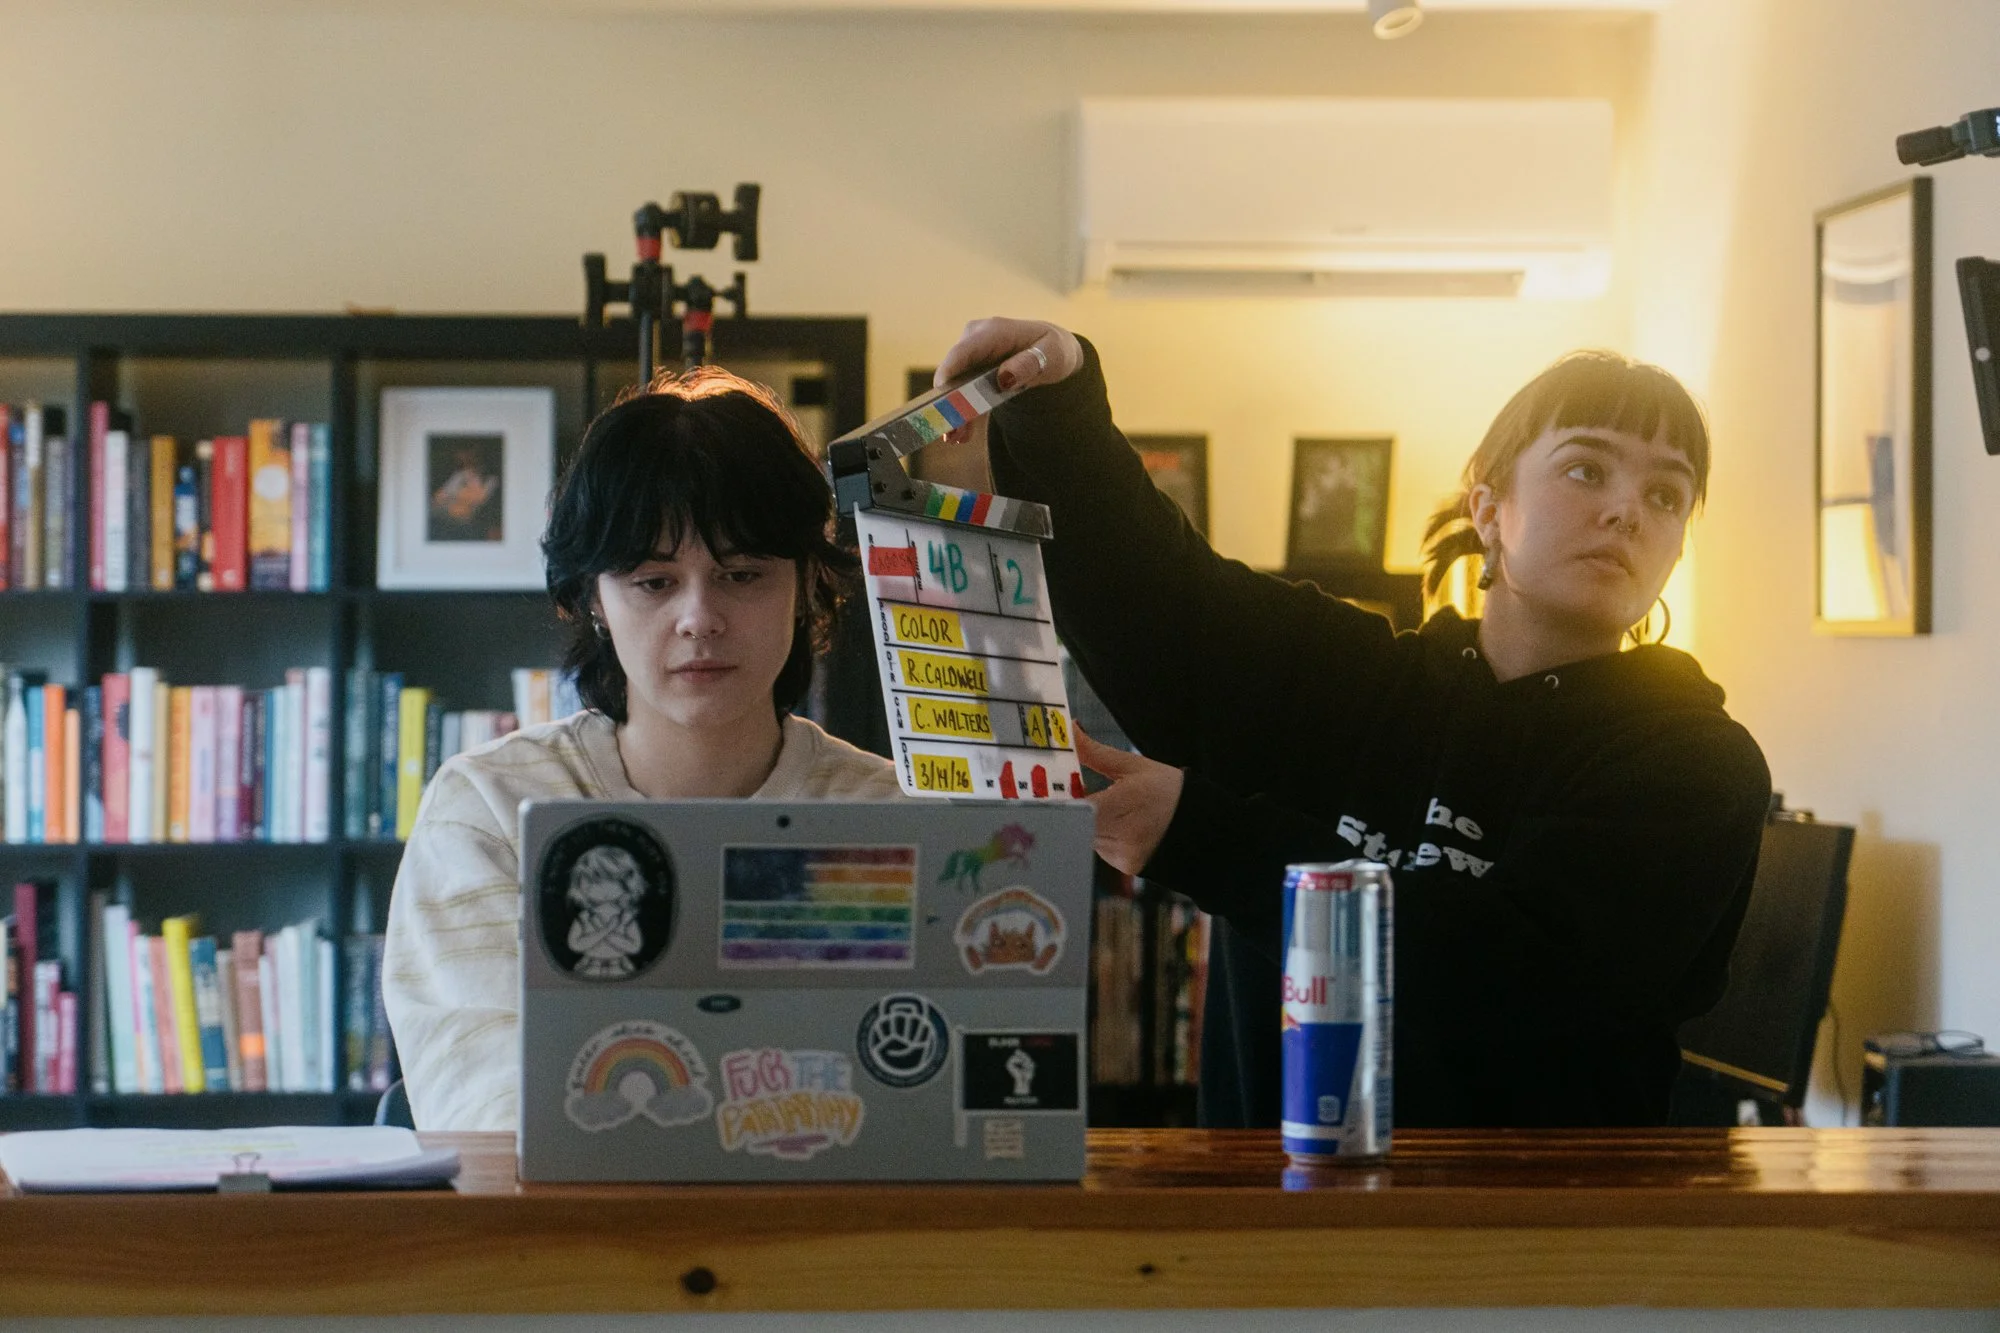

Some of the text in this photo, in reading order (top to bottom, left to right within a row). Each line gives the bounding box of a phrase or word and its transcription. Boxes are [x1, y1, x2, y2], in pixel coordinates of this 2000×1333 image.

[928, 539, 968, 594] 4B
[1007, 559, 1033, 604] 2
[900, 613, 953, 643] COLOR
[893, 696, 904, 728] CAM
[934, 709, 990, 734] WALTERS
[1032, 713, 1043, 738] A
[901, 742, 913, 786] DATE
[920, 760, 970, 790] 3/14/26
[1282, 976, 1327, 1005] Bull
